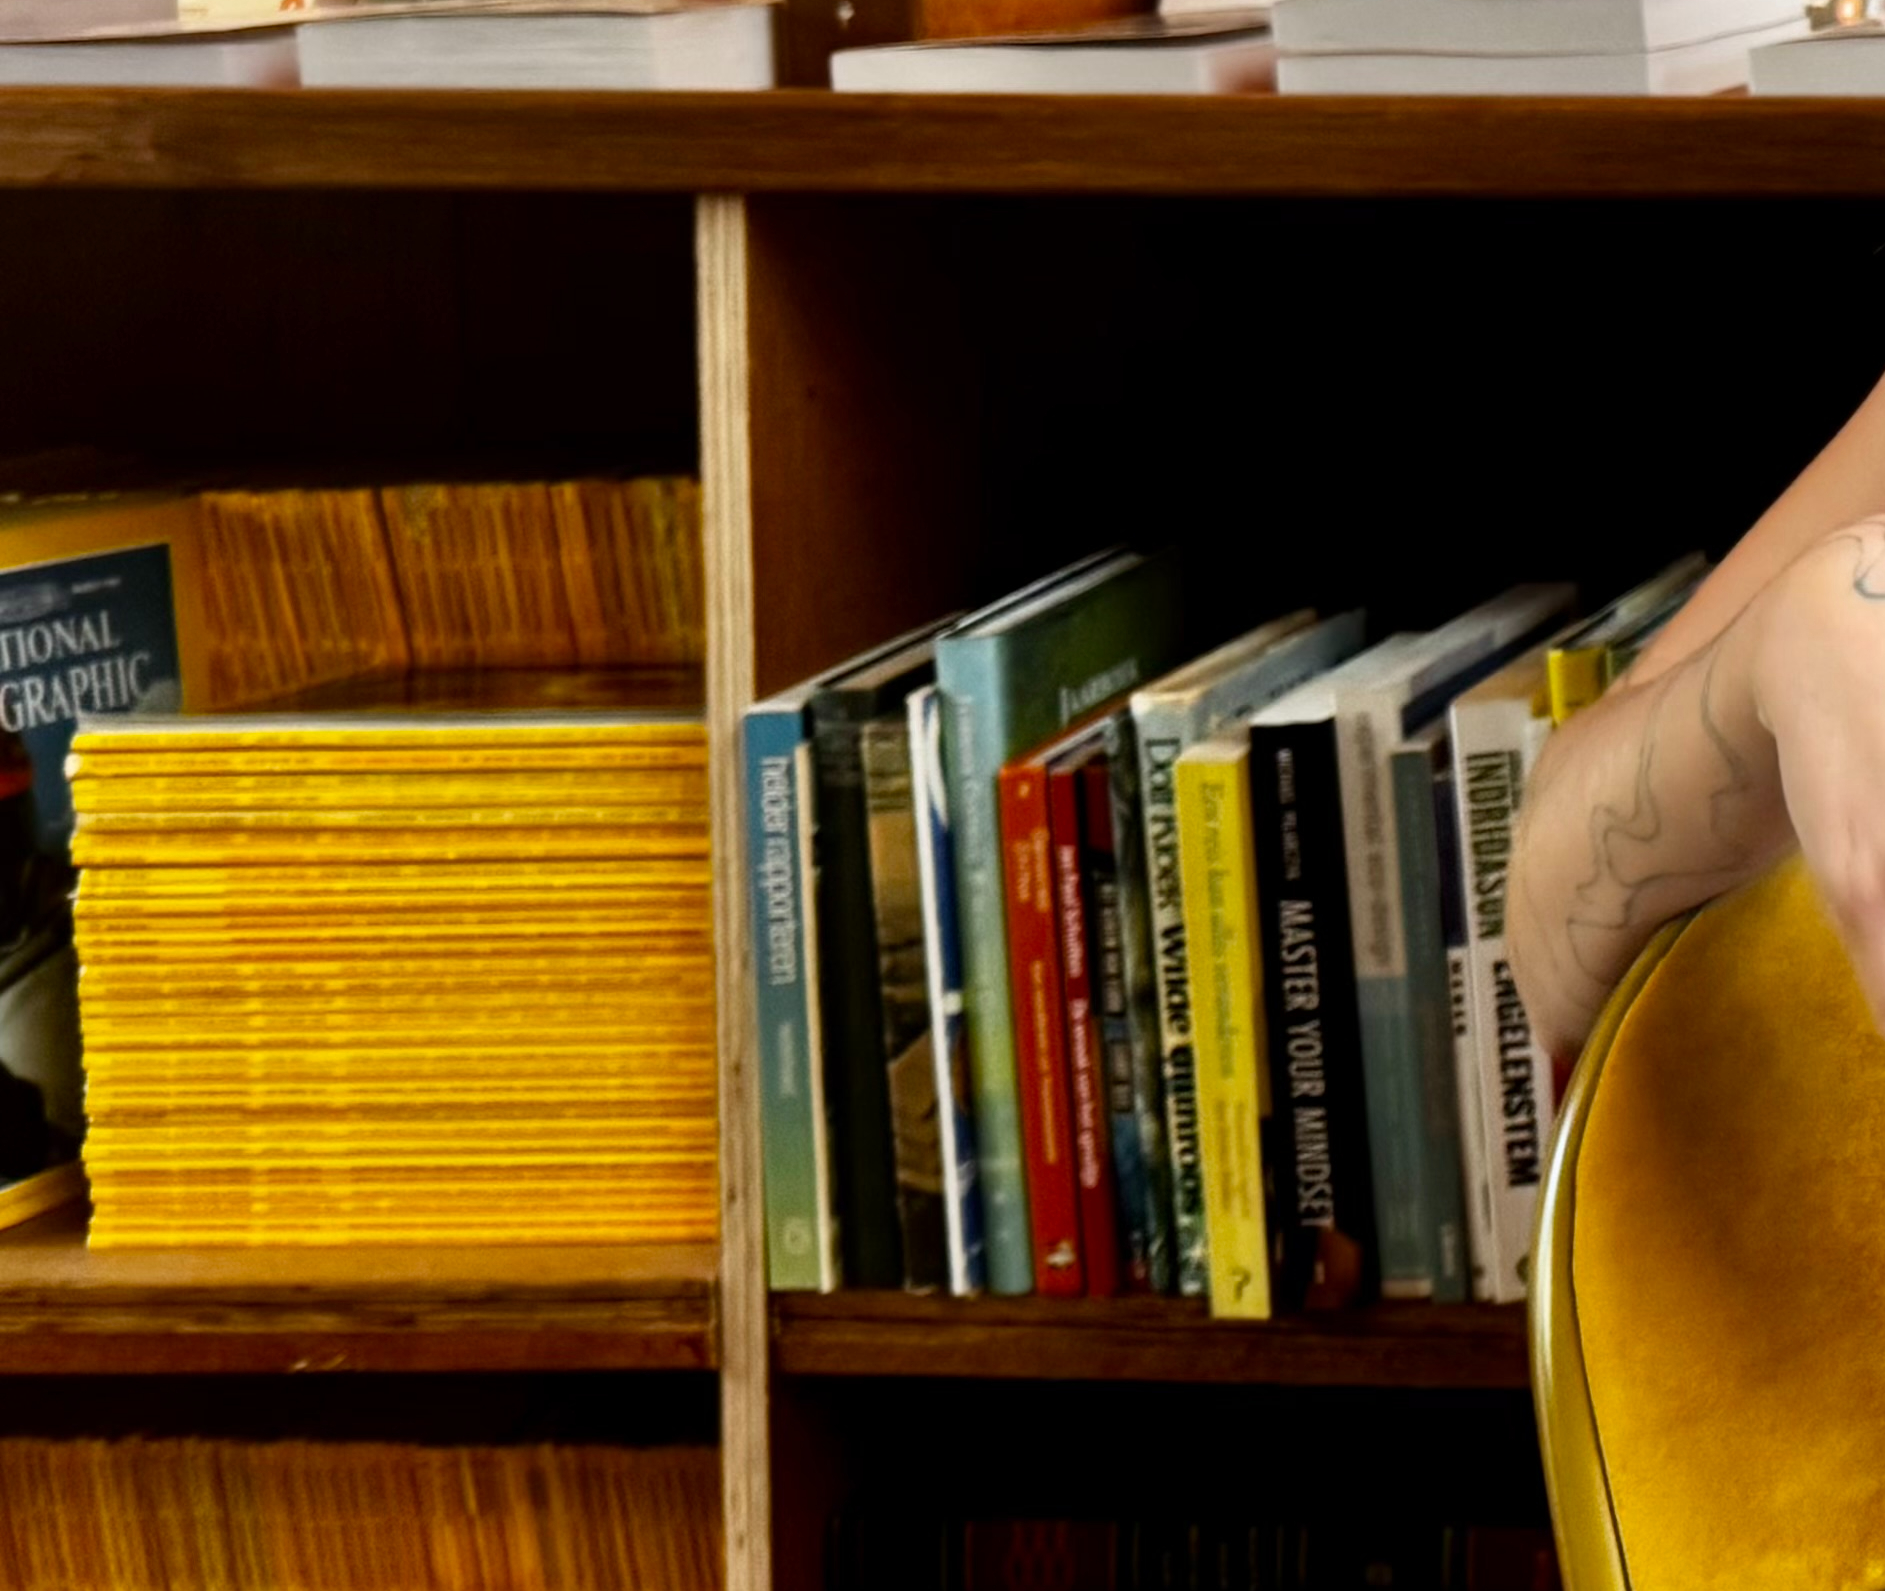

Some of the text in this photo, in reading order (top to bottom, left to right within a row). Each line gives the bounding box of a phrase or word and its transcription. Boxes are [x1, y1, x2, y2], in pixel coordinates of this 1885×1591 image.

[0, 649, 151, 733] GRAPHIC
[761, 755, 795, 836] helder
[1279, 899, 1334, 1229] MASTER YOUR MINDSET
